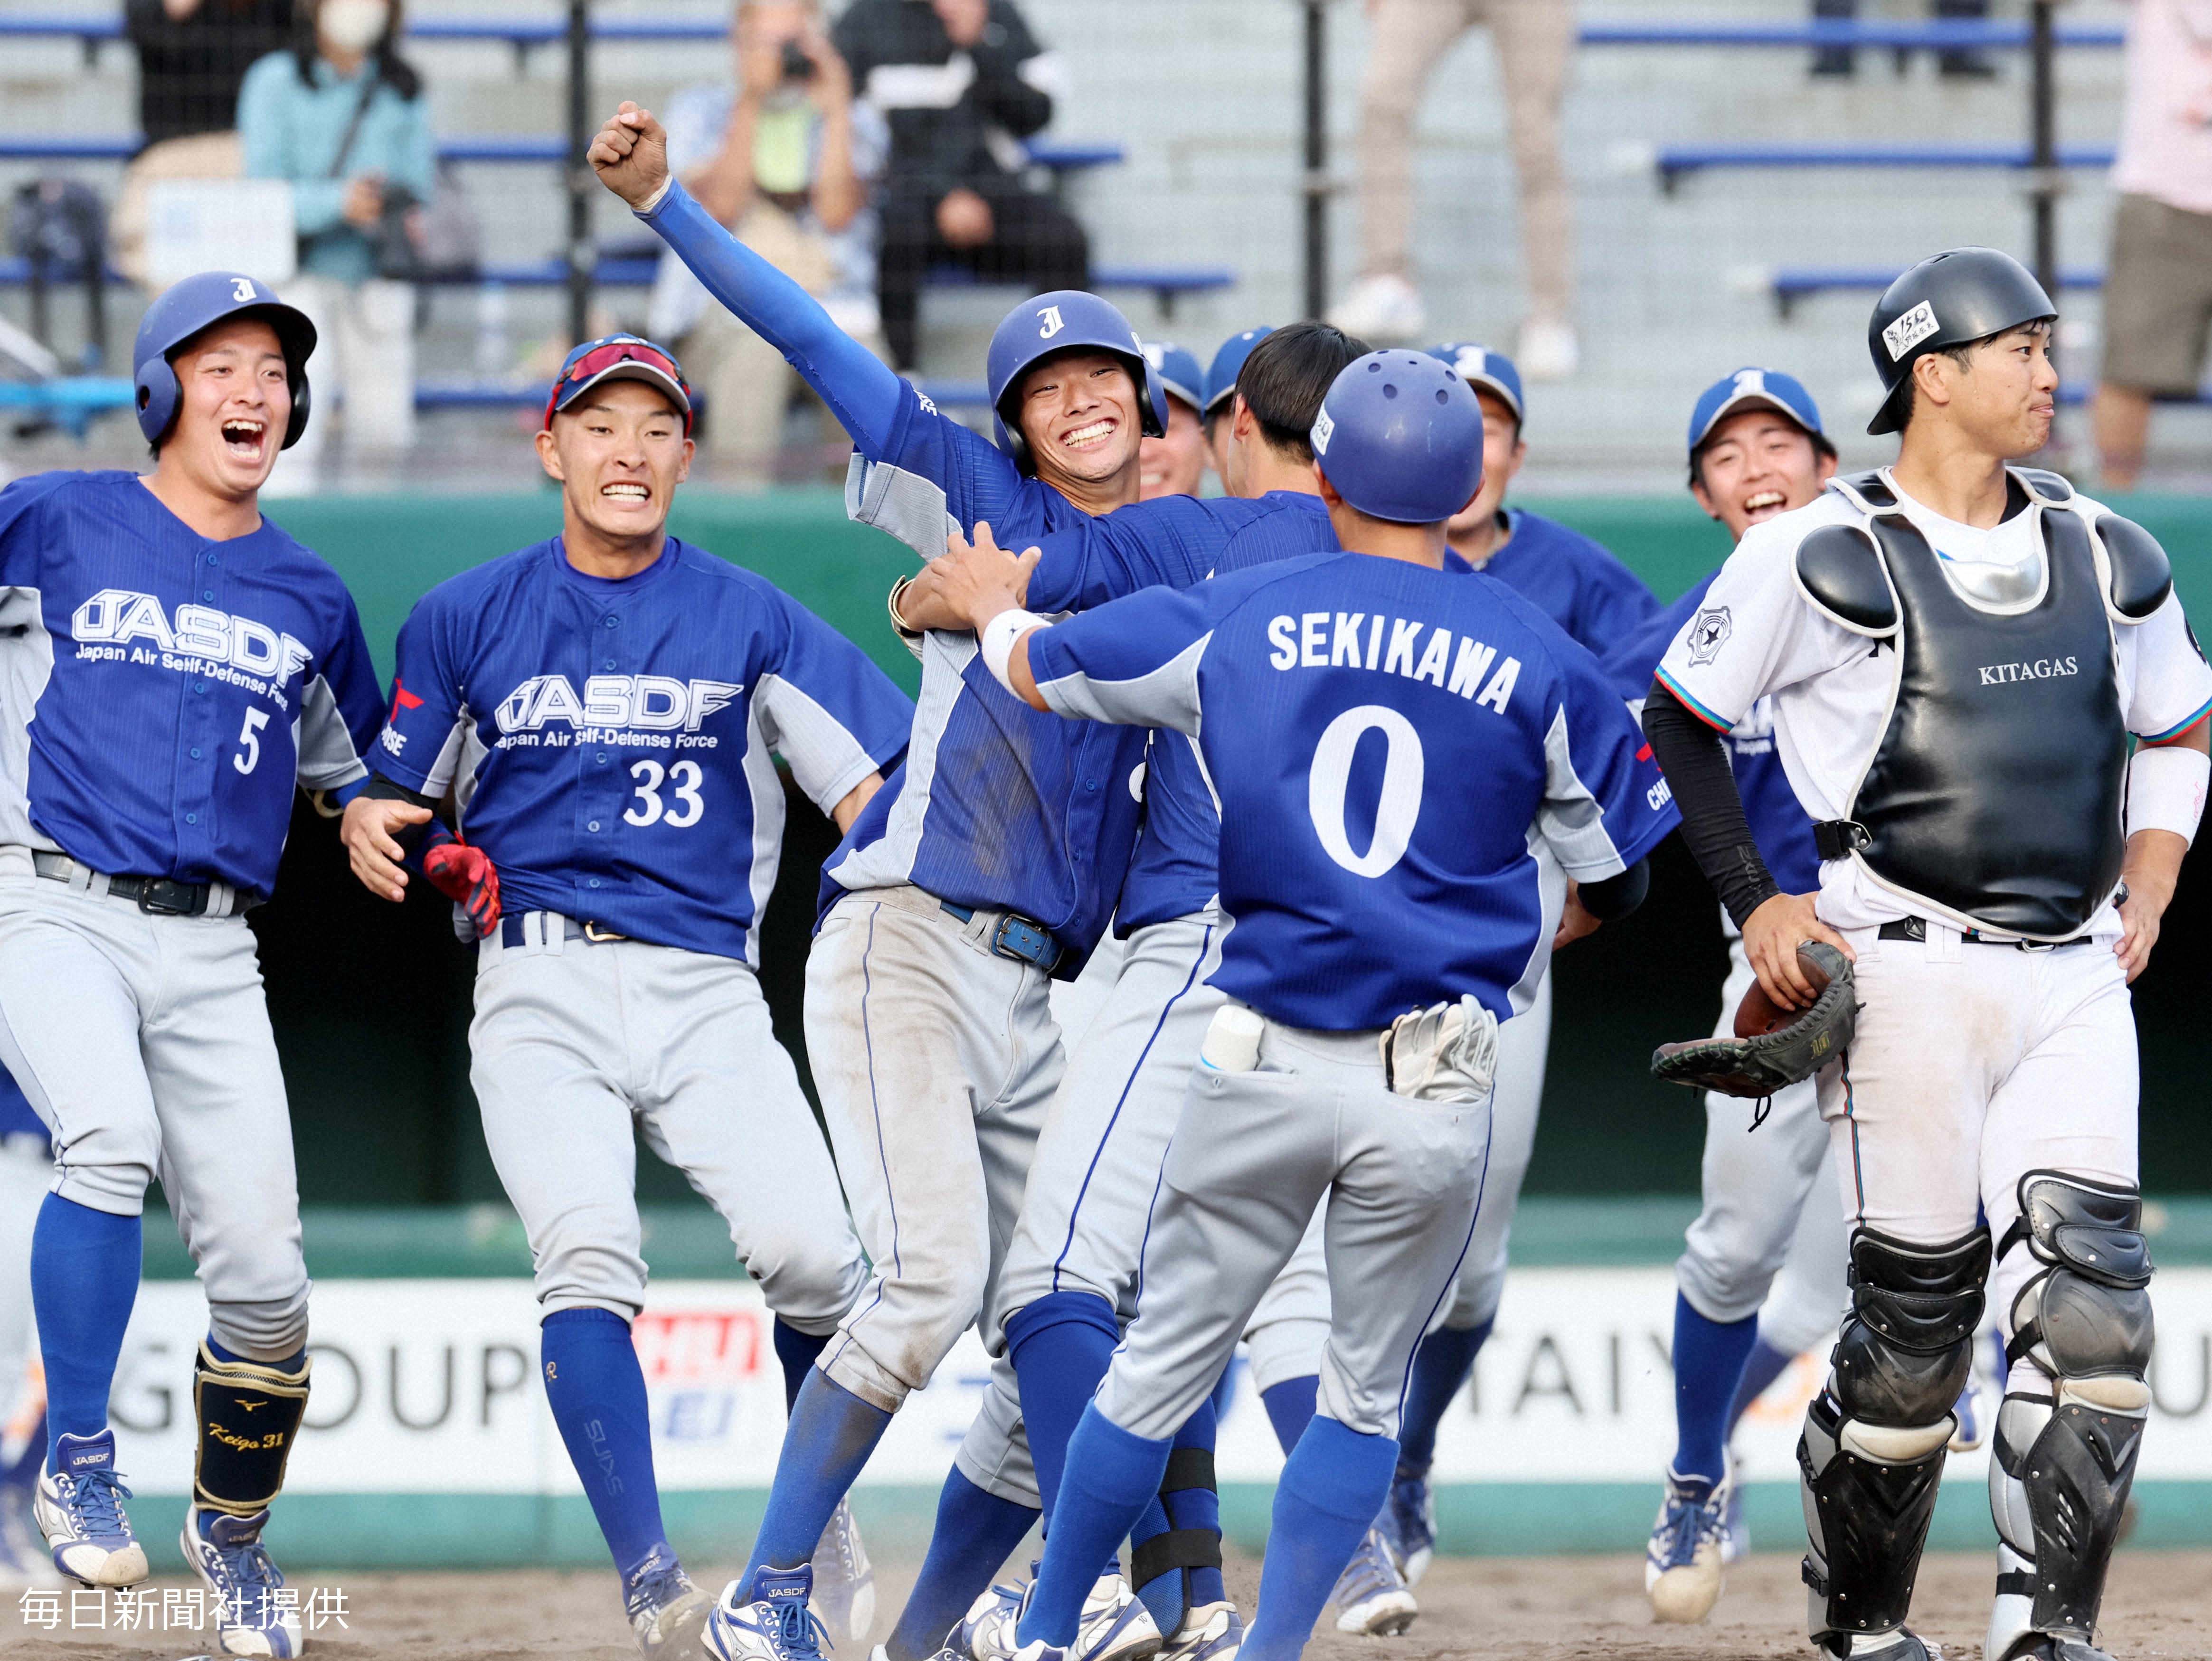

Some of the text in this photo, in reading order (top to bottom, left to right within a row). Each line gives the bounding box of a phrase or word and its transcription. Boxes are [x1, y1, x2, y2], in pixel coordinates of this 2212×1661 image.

[1037, 305, 1065, 339] J
[72, 588, 313, 689] JASDF
[1267, 612, 1521, 715] SEKIKAWA
[76, 643, 288, 712] Japan Air Self-Defense Force
[1978, 656, 2078, 685] KITAGAS
[494, 675, 744, 734] JASDF
[233, 706, 270, 775] 5
[544, 731, 571, 747] Air
[575, 727, 671, 749] Self-Defense
[675, 733, 718, 749] Force
[623, 760, 704, 828] 33
[1309, 705, 1424, 878] 0
[107, 1343, 529, 1430] GOUP
[73, 1453, 109, 1465] JASDF
[263, 1432, 284, 1449] 31
[768, 1587, 806, 1597] JASDF
